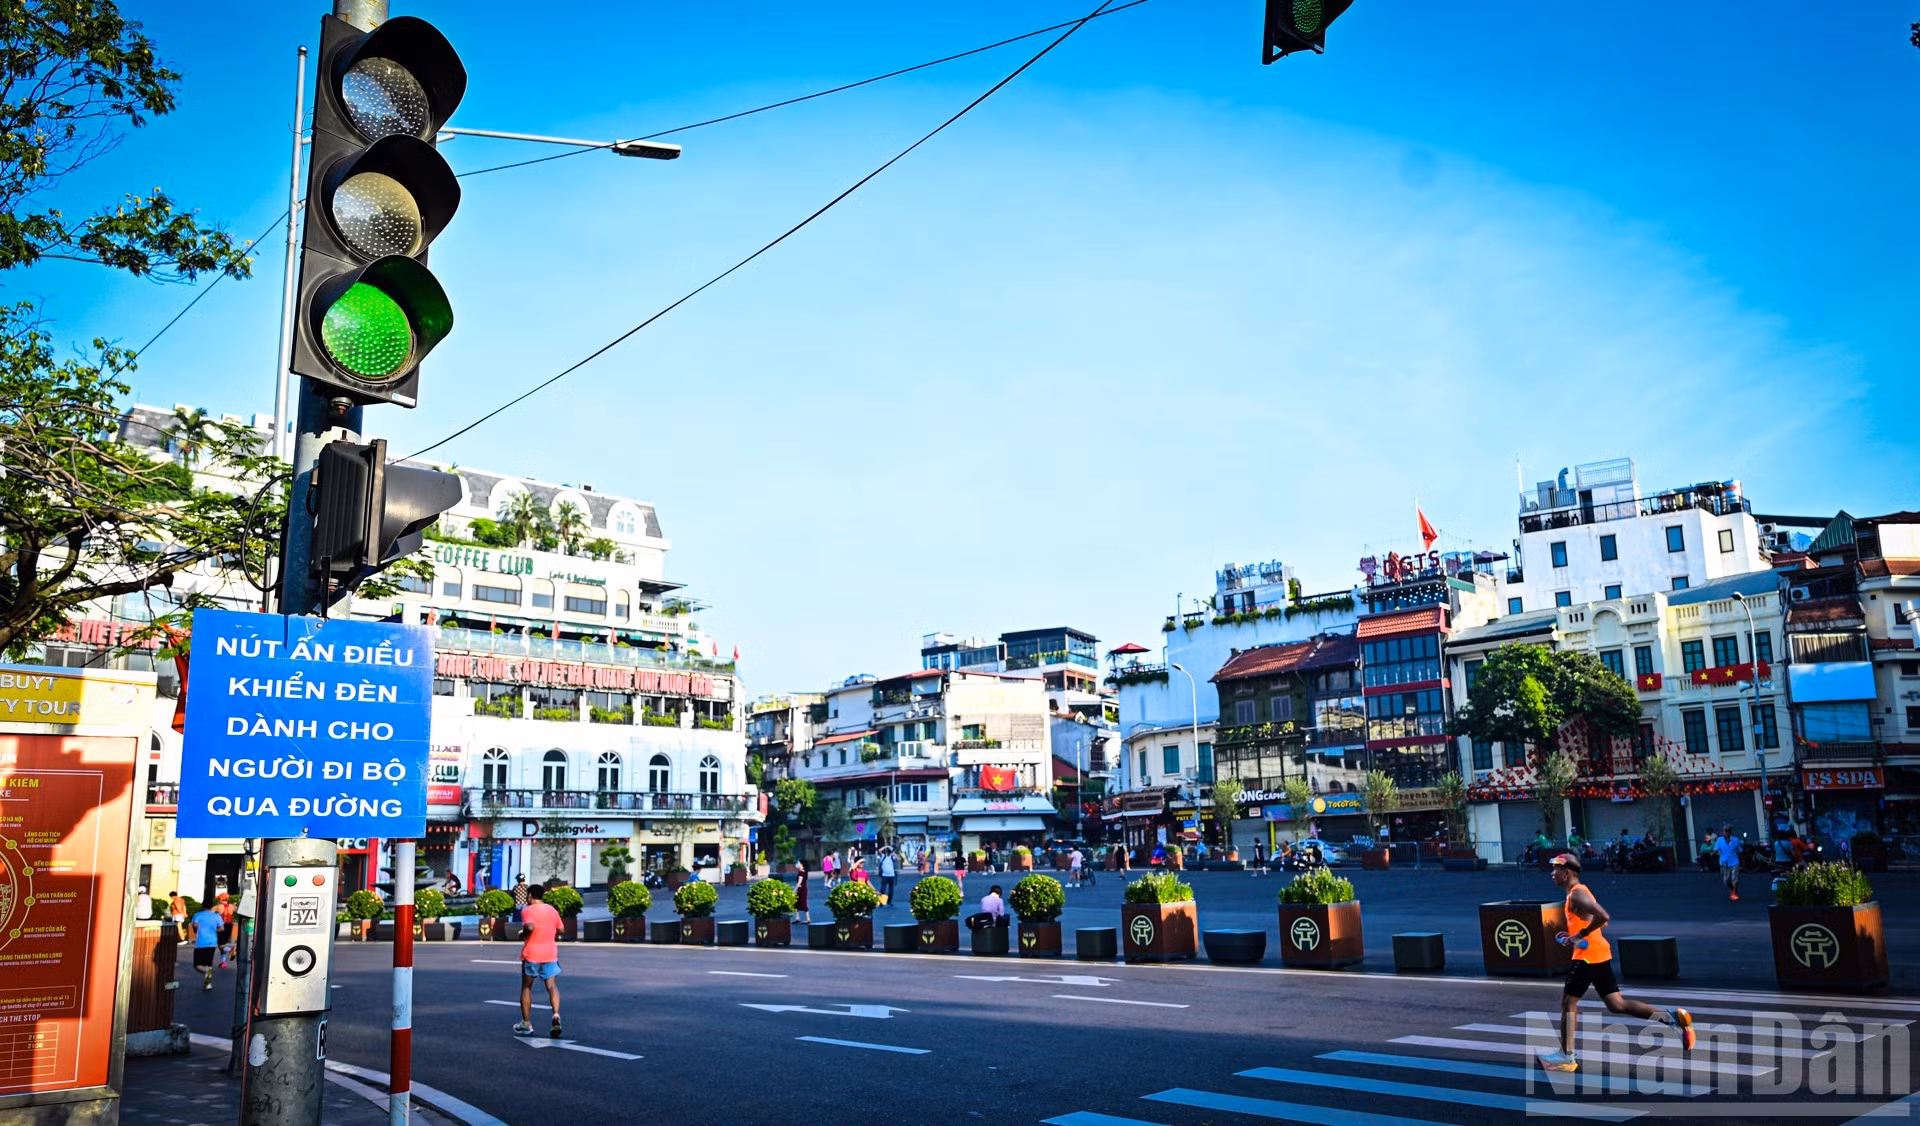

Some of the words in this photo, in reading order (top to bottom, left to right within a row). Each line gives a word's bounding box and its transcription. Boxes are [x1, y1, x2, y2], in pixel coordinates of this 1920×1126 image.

[435, 544, 490, 571] COFFEE
[499, 554, 534, 575] CLUB
[1259, 559, 1282, 574] Cafe
[216, 634, 281, 659] NÚT
[290, 635, 334, 662] ẤN
[343, 640, 413, 666] ĐIỀU
[228, 671, 325, 700] KHIỂN
[335, 679, 397, 703] ĐÈN
[24, 700, 81, 716] TOUR
[227, 713, 317, 739] DÀNH
[328, 721, 394, 741] CHO
[208, 755, 313, 779] NGƯỜI
[322, 761, 352, 780] ĐI
[362, 758, 407, 786] BỘ
[1837, 770, 1877, 785] SPA
[207, 796, 279, 818] QUA
[288, 793, 402, 818] ĐƯỜNG
